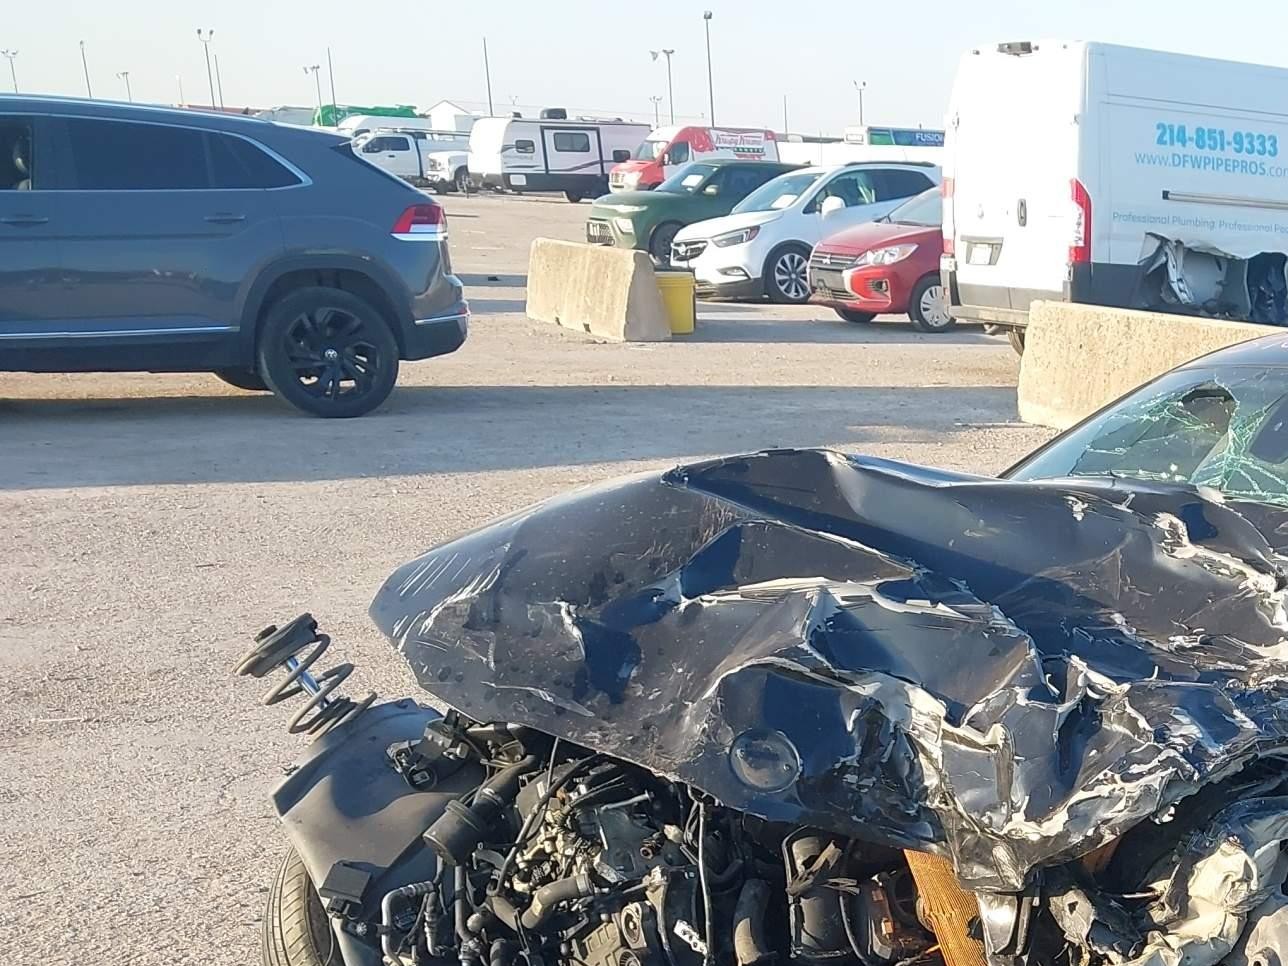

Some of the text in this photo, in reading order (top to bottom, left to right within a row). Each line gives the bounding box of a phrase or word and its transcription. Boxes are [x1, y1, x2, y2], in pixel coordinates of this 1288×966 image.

[1156, 122, 1278, 157] 214-851-9333
[1112, 211, 1170, 225] Professional
[1219, 218, 1273, 233] Professional
